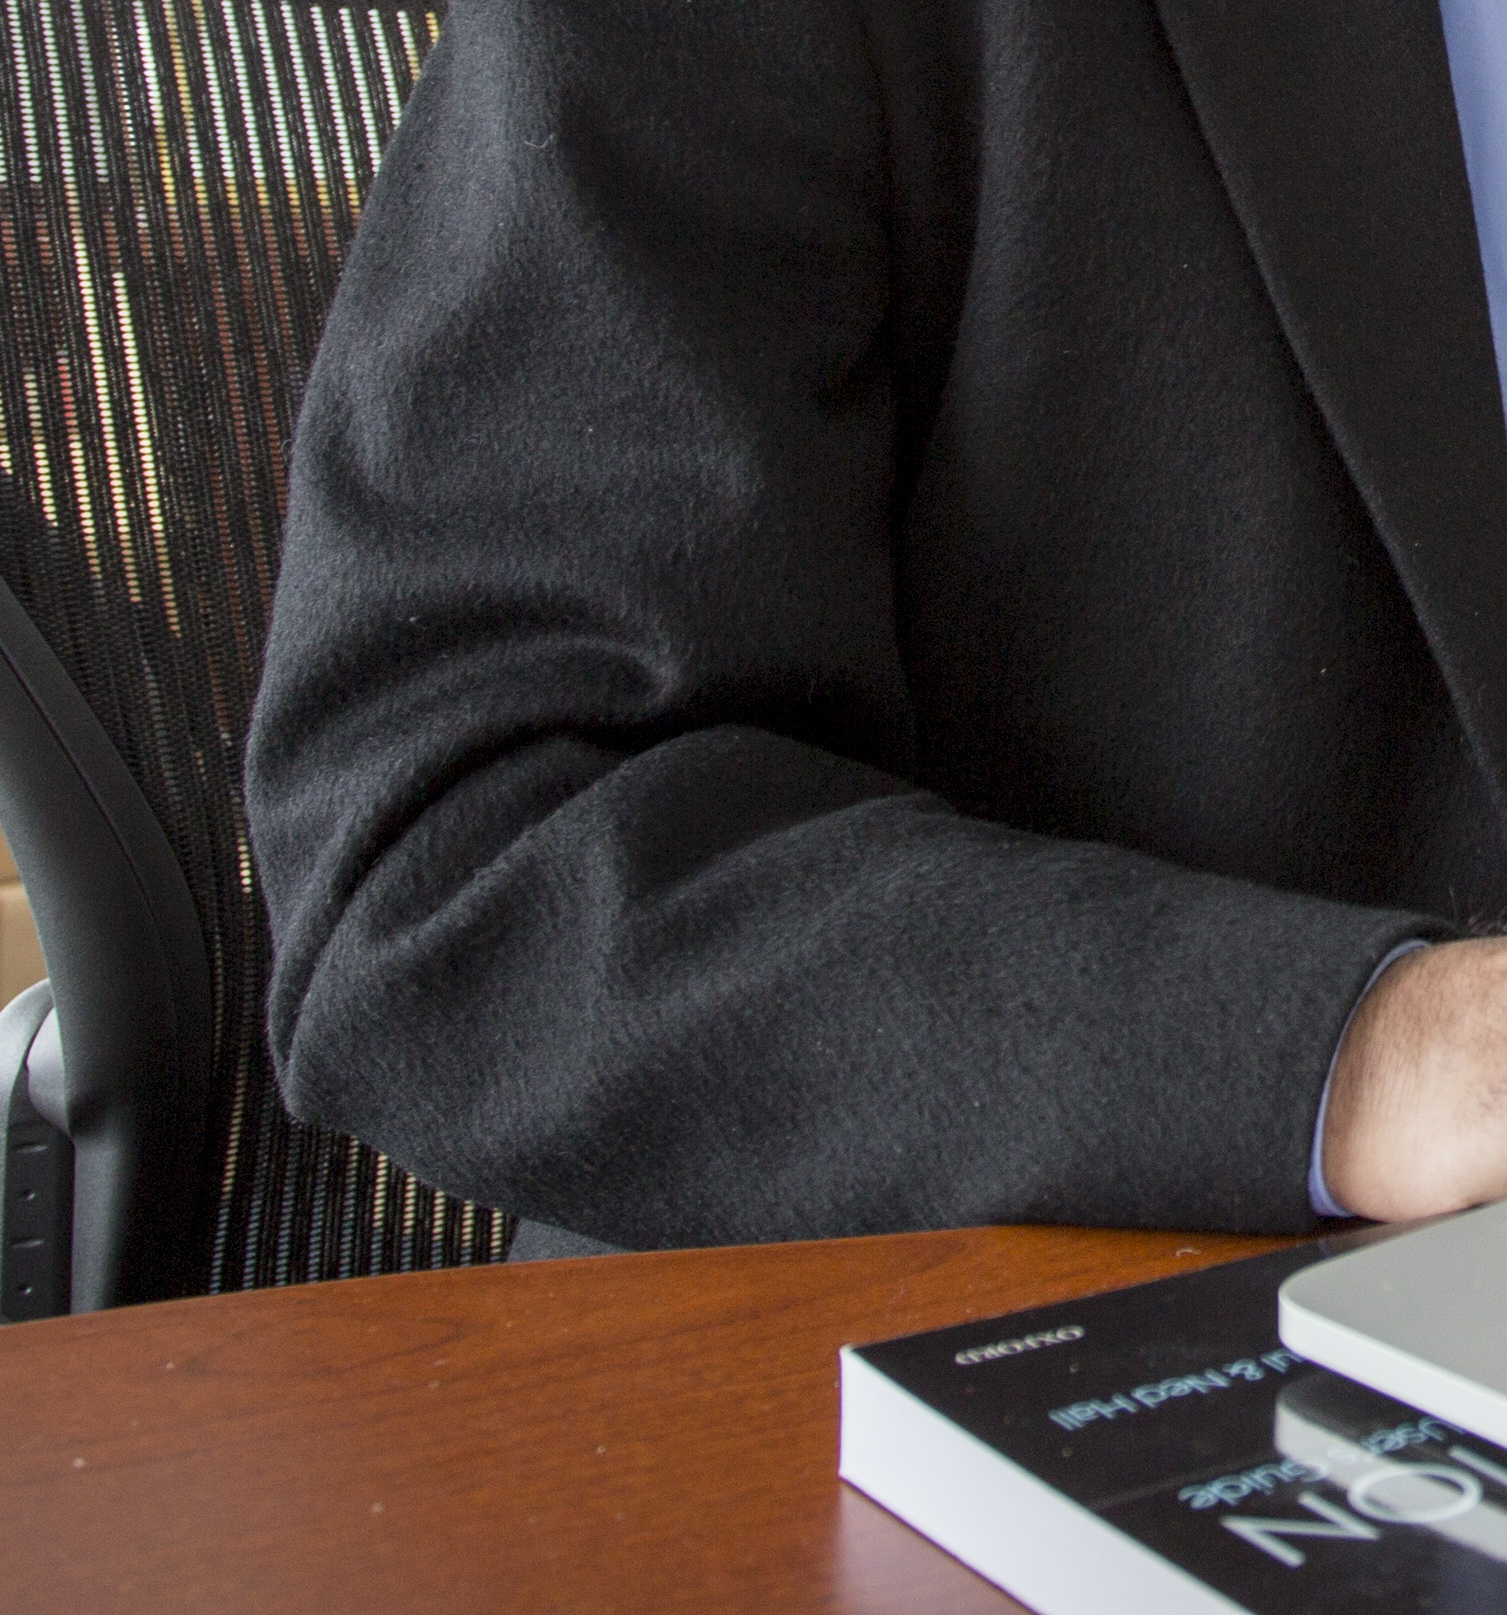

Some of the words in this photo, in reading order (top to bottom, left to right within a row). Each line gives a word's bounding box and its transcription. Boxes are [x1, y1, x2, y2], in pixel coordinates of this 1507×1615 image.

[955, 1324, 1085, 1365] OXFORD
[1130, 1368, 1231, 1409] Ned
[1222, 1358, 1265, 1381] &
[1048, 1392, 1138, 1431] Hall
[1177, 1458, 1330, 1509] Guide
